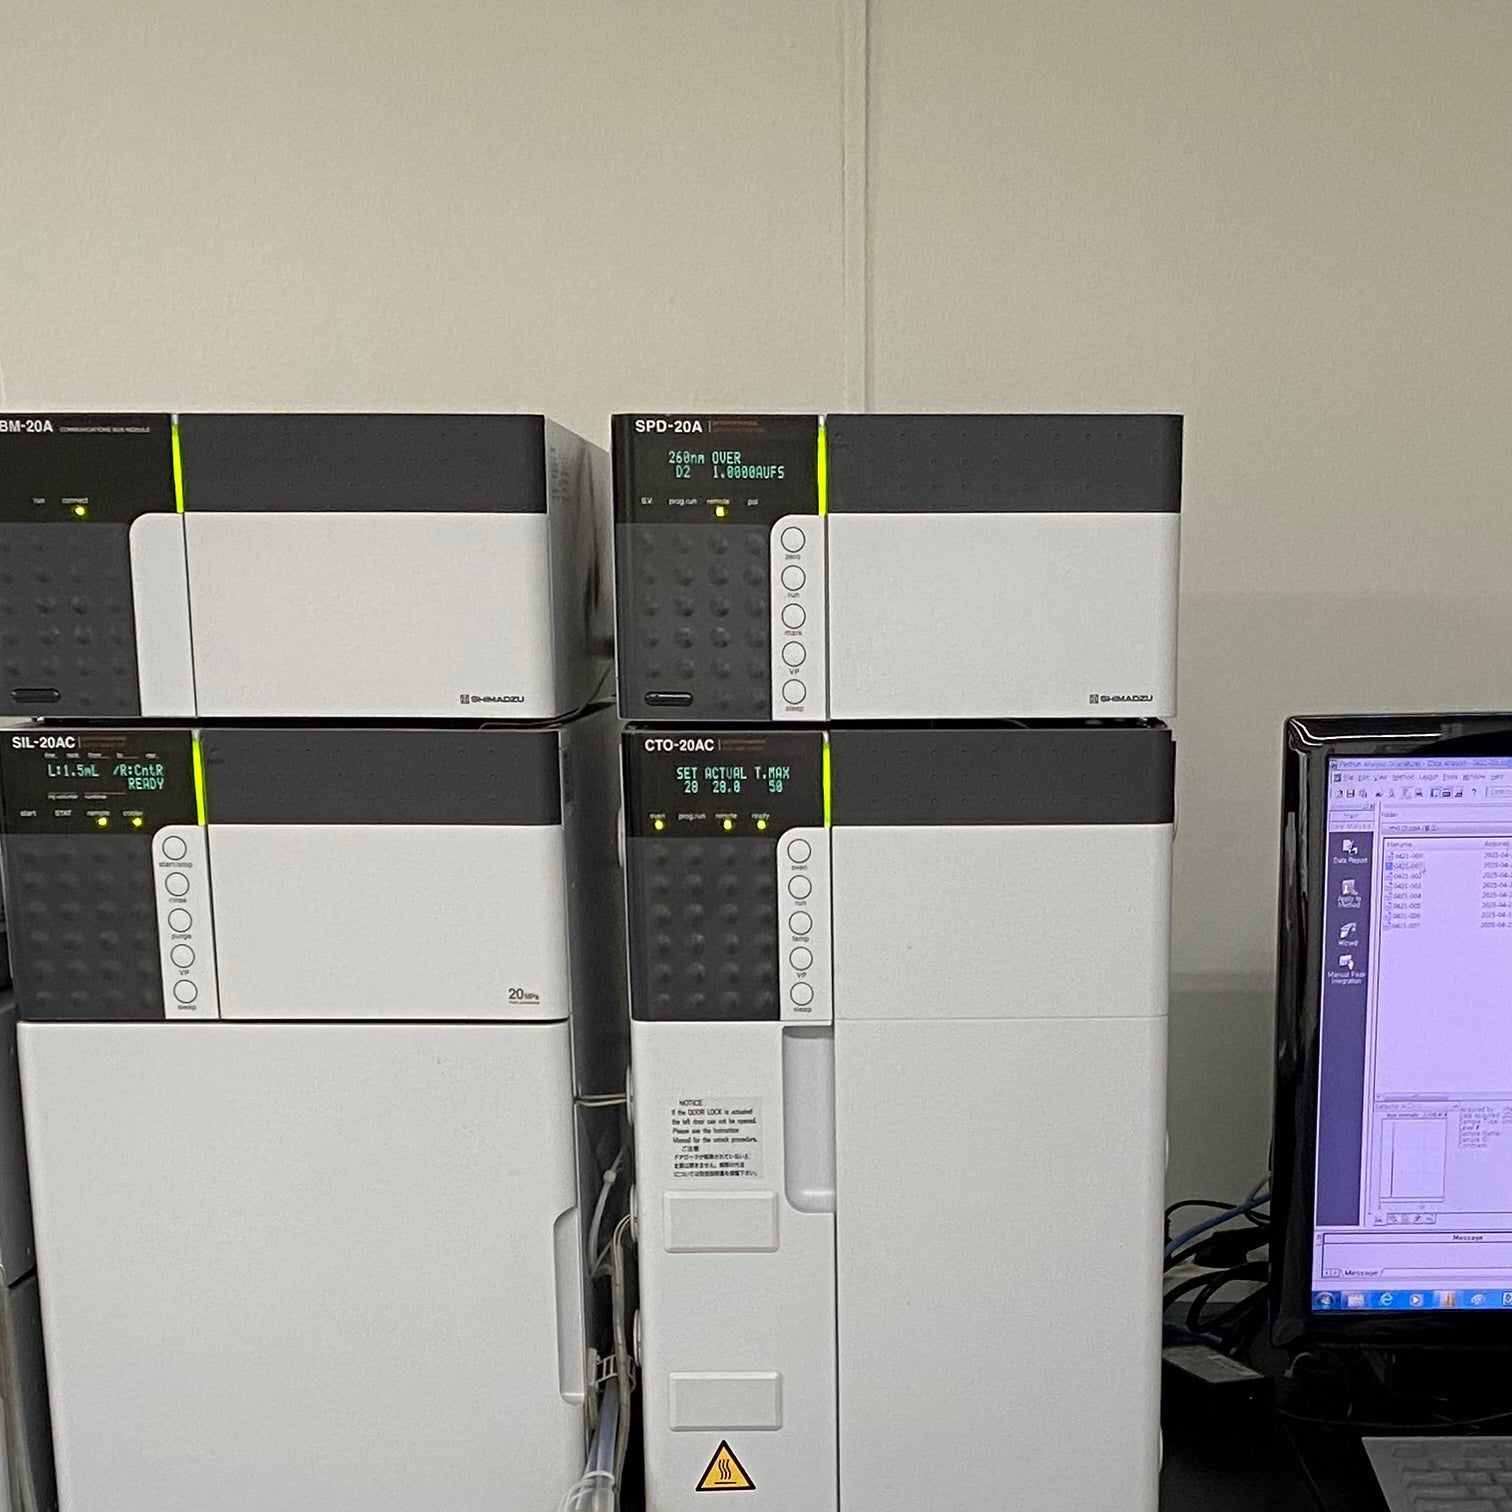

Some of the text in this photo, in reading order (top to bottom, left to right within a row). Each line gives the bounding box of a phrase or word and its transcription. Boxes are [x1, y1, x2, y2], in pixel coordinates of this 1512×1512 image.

[634, 419, 703, 433] SPD-20A
[668, 451, 742, 464] 260nm OVER
[676, 465, 785, 479] D2 1.0000AUFS
[788, 668, 800, 676] VP
[471, 695, 525, 703] SHIMADZU
[12, 736, 76, 749] SIL-20AC
[644, 738, 714, 751] CTO-20AC
[48, 764, 164, 777] L:1.5mL /R:CntR
[676, 766, 790, 779] SET ACTUAL T.MAX
[128, 777, 164, 790] READY
[684, 780, 783, 793] 28 28.0 50
[509, 988, 524, 1000] 20
[687, 1108, 705, 1116] DOOR
[707, 1108, 722, 1116] LOCK
[1452, 1234, 1484, 1242] Message
[1344, 1269, 1379, 1277] Message
